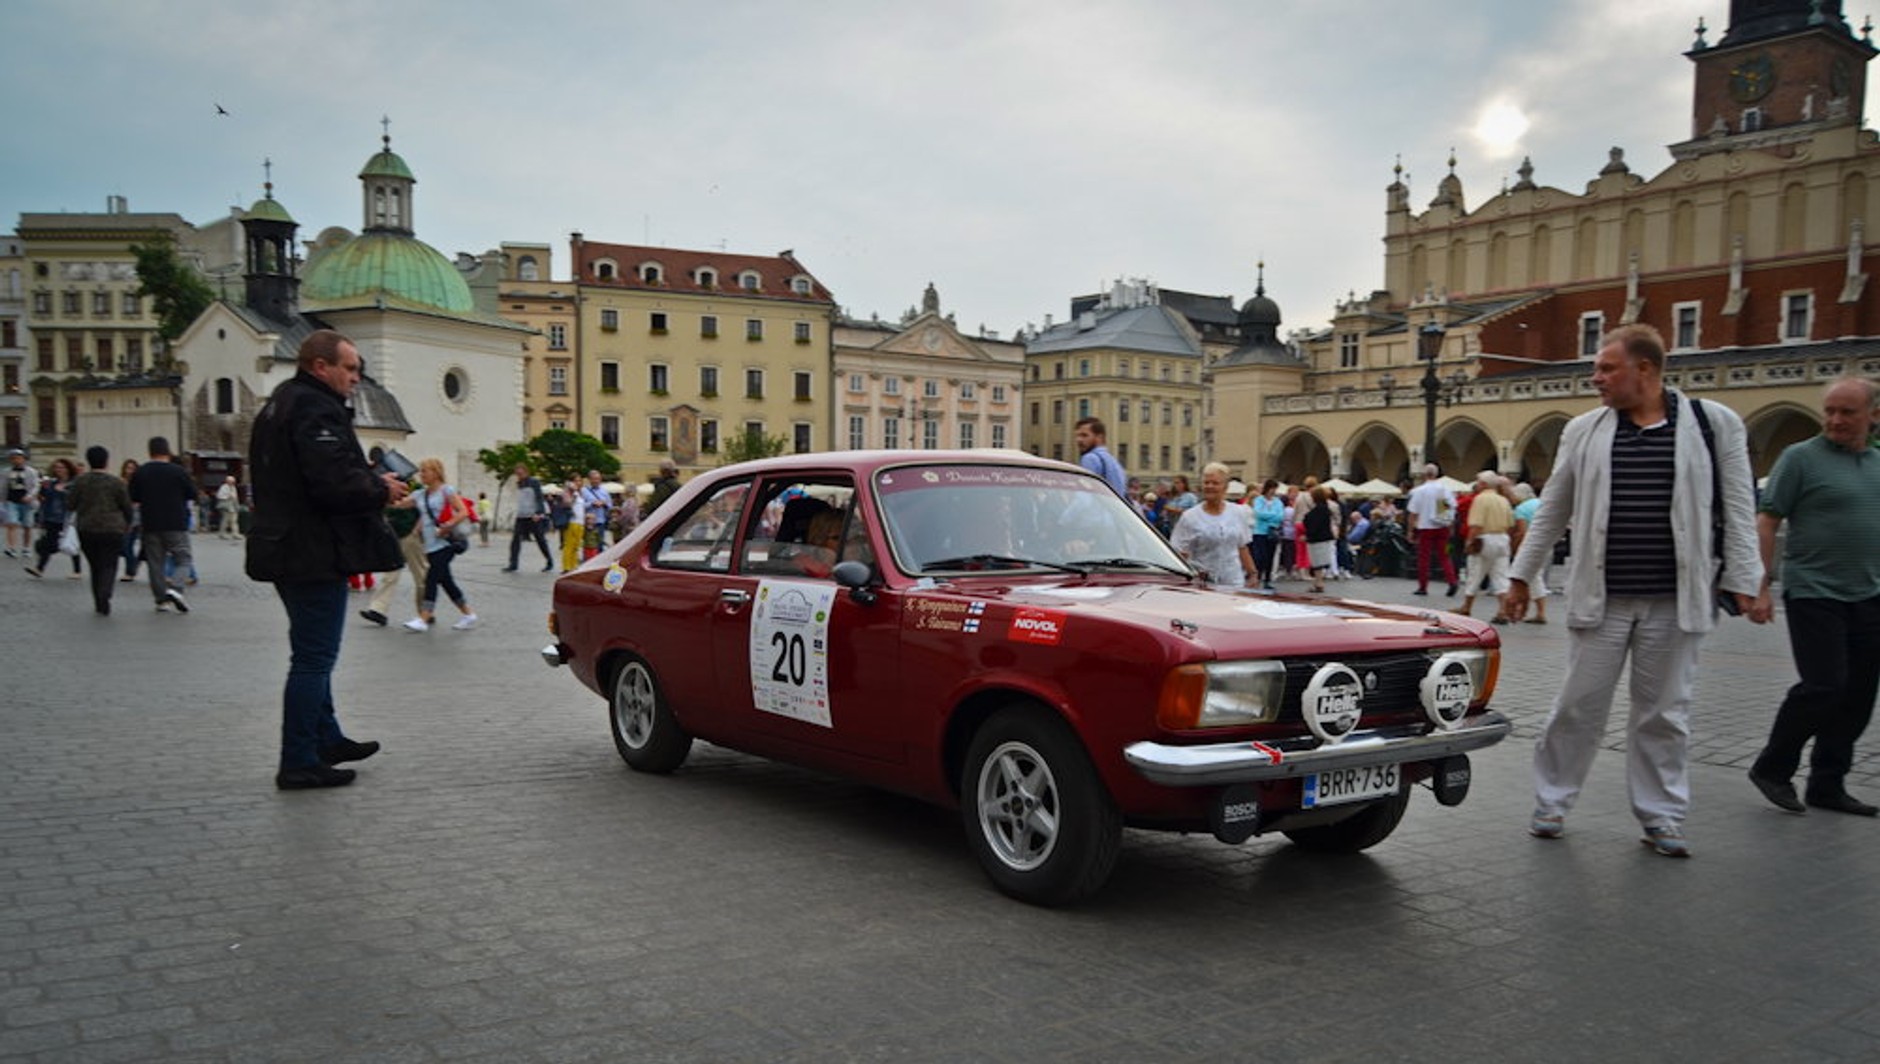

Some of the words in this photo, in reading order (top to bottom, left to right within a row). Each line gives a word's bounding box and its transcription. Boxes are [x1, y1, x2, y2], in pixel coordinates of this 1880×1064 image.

[1014, 618, 1058, 633] NOVOL
[772, 632, 806, 687] 20
[1319, 763, 1397, 798] BRR-736
[1224, 802, 1258, 817] BOSCH
